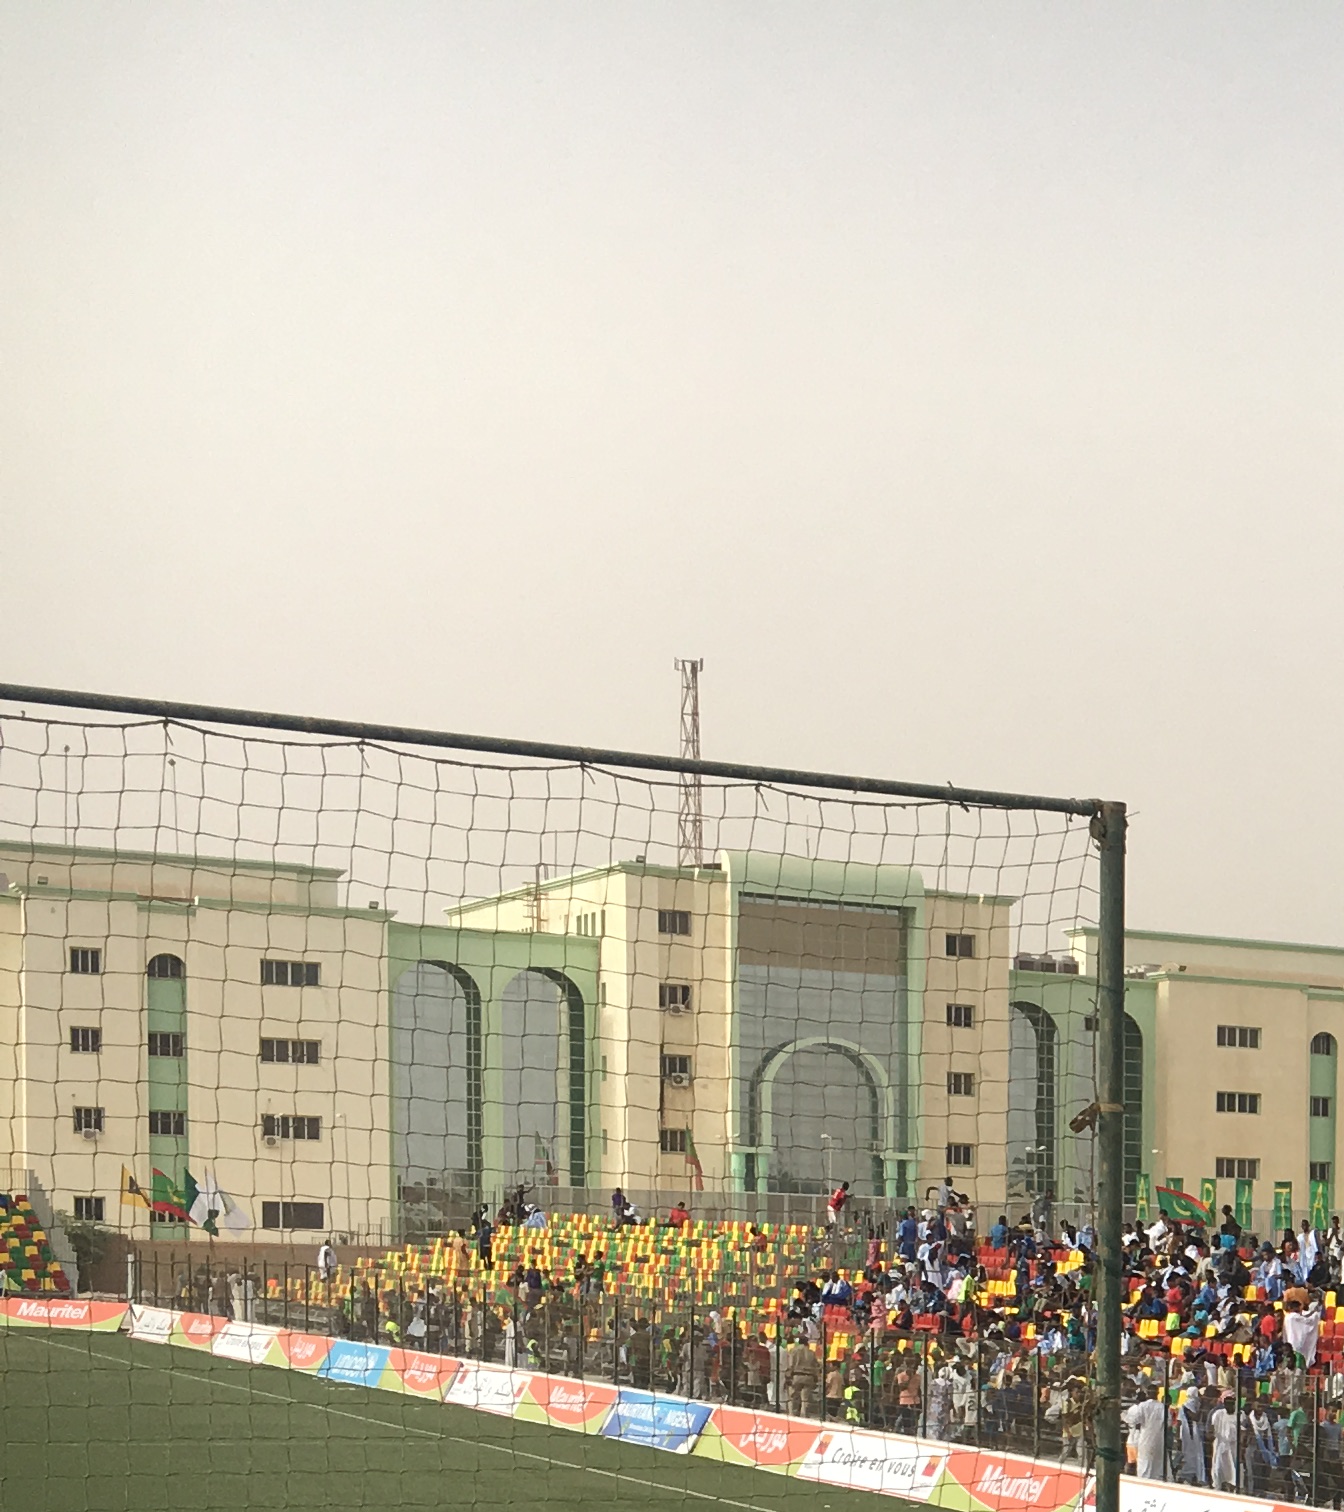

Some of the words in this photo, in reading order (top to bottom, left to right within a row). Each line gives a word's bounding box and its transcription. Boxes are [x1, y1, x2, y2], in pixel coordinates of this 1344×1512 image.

[17, 1302, 88, 1320] Mauritel
[831, 1447, 864, 1469] Croire
[869, 1457, 884, 1471] en
[887, 1459, 916, 1478] vous
[976, 1464, 1049, 1504] Mauritel
